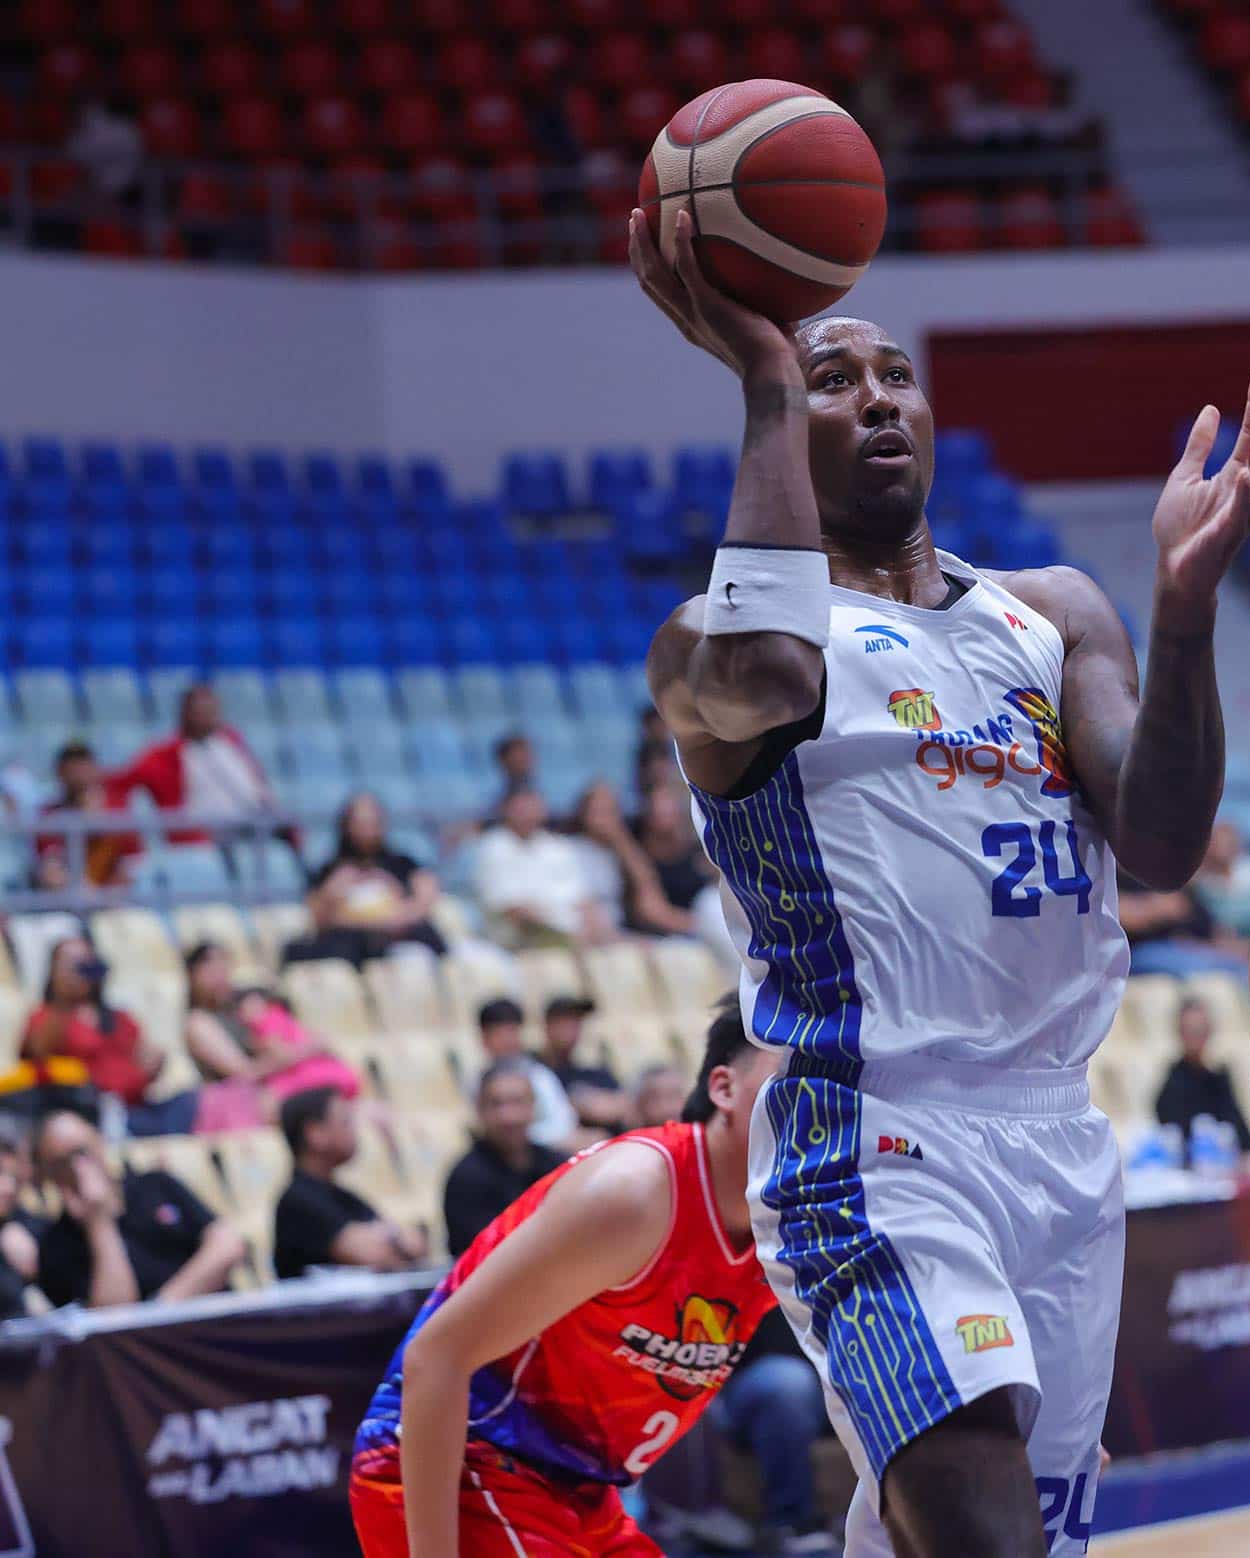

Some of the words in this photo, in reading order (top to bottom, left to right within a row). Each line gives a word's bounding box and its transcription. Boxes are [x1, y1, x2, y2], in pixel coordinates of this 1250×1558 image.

[865, 637, 893, 653] ANTA
[888, 691, 935, 729] TNT
[981, 820, 1092, 917] 24
[956, 1316, 1009, 1354] TNT
[624, 1411, 679, 1474] 2
